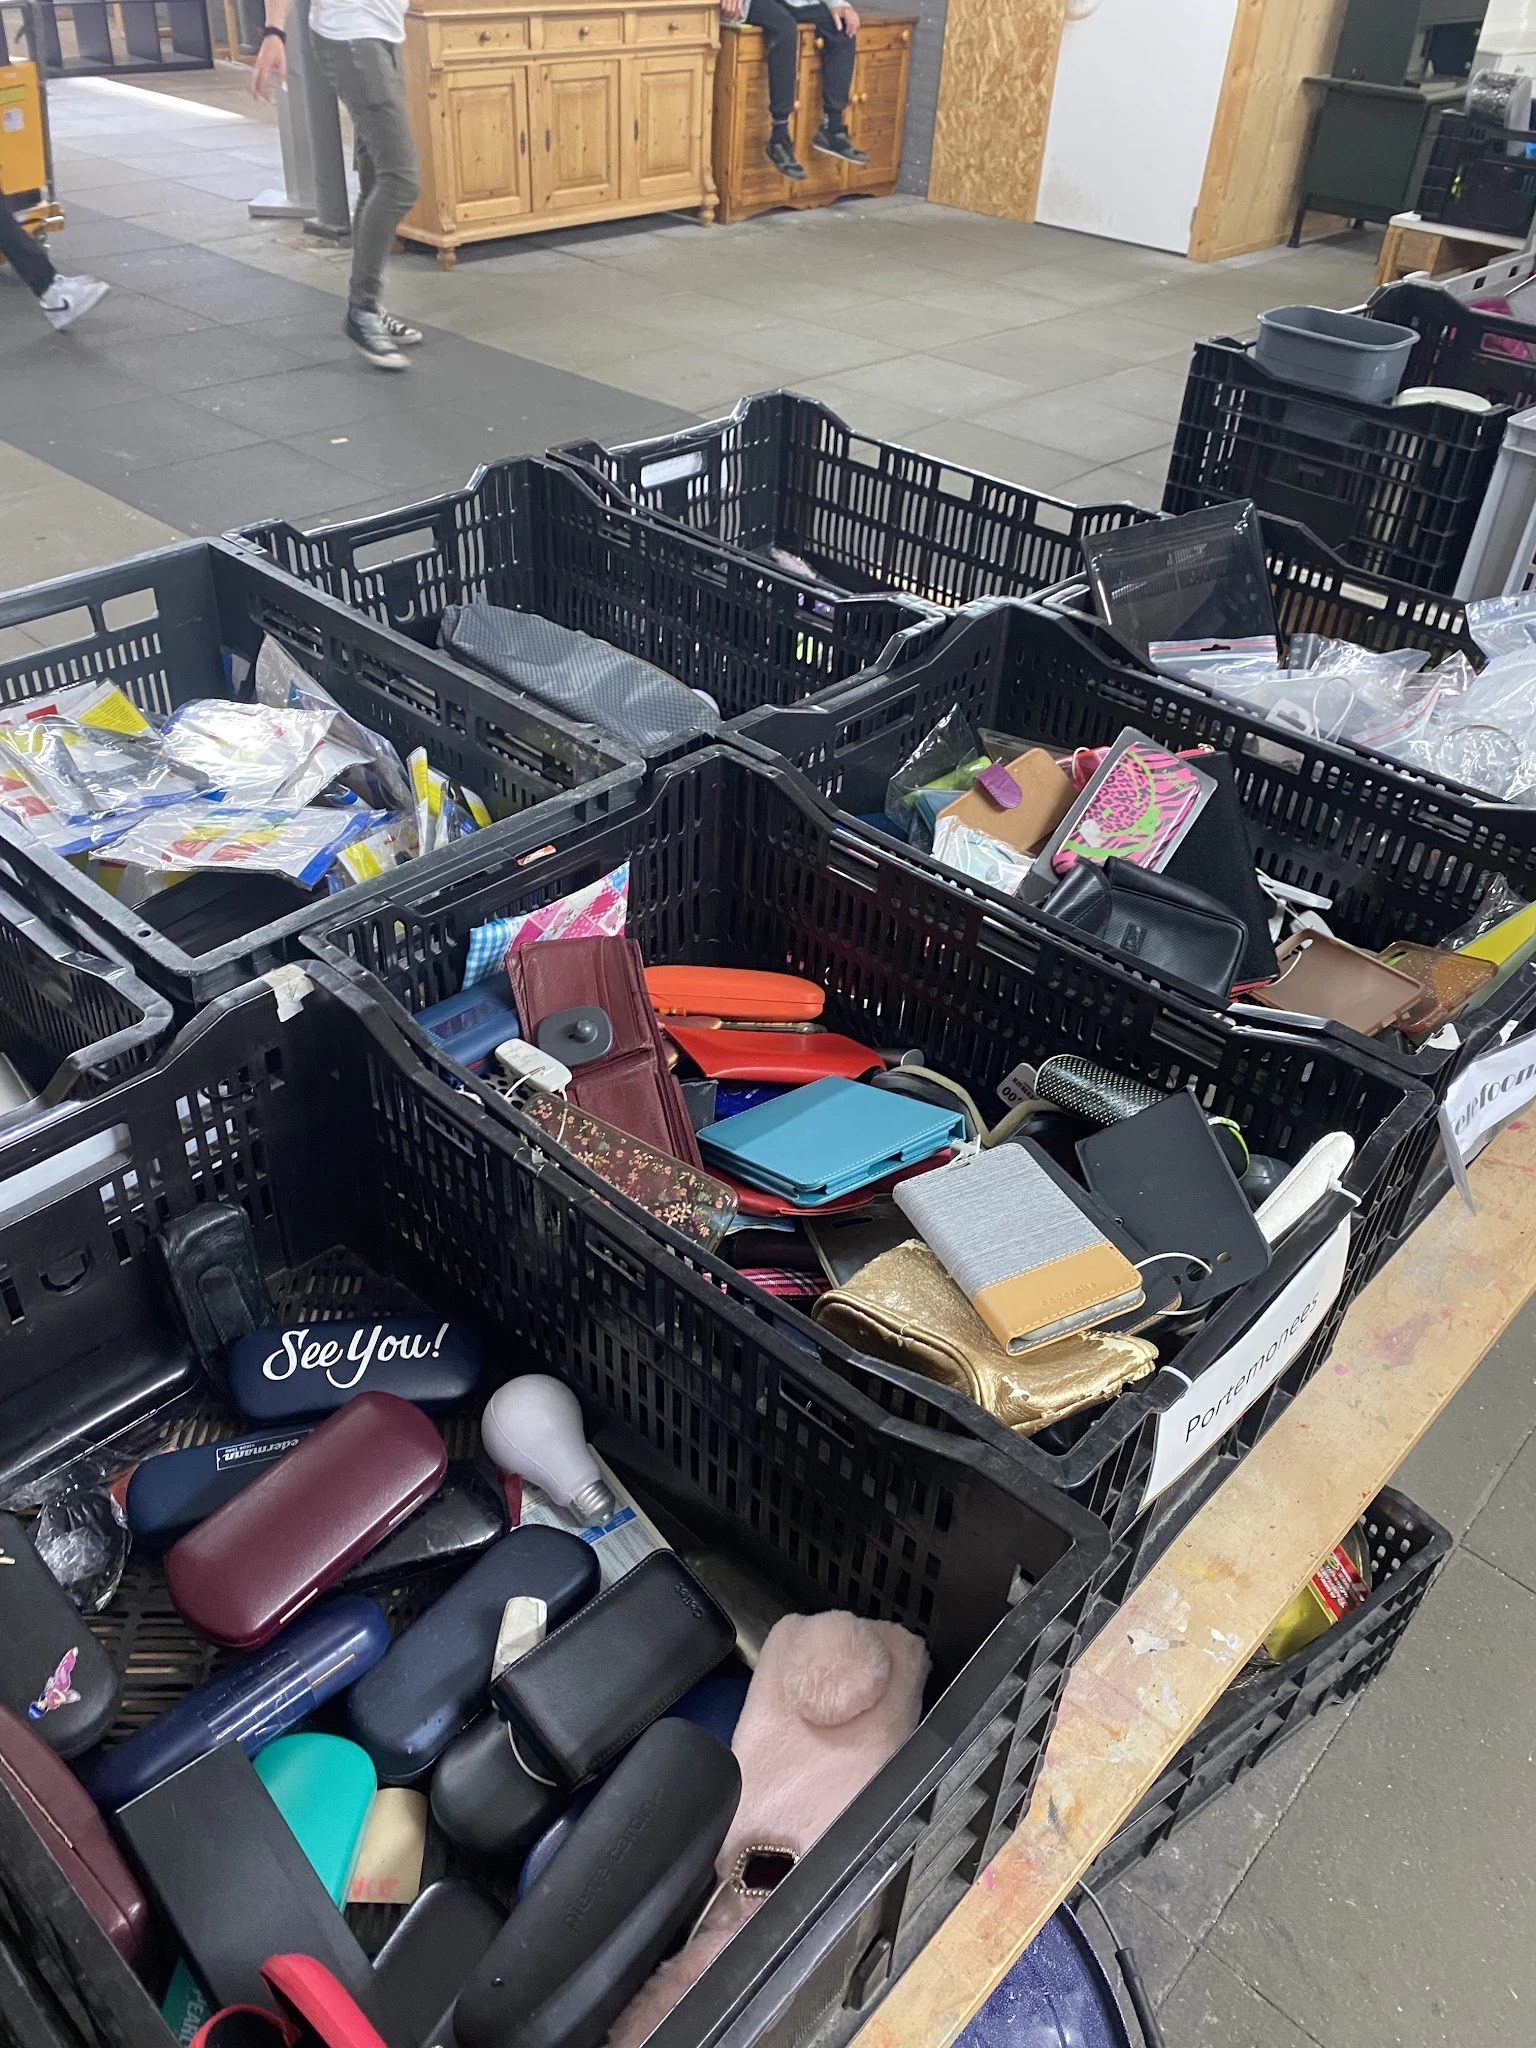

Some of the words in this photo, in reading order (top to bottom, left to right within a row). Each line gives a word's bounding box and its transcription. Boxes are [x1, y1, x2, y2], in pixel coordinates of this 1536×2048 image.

[1450, 1063, 1536, 1136] elefoon
[262, 1329, 344, 1381] See
[326, 1322, 450, 1389] You!
[1185, 1292, 1319, 1443] Portemonees
[222, 1438, 300, 1462] edermann
[564, 1866, 610, 1931] pierre
[610, 1799, 657, 1864] cardin
